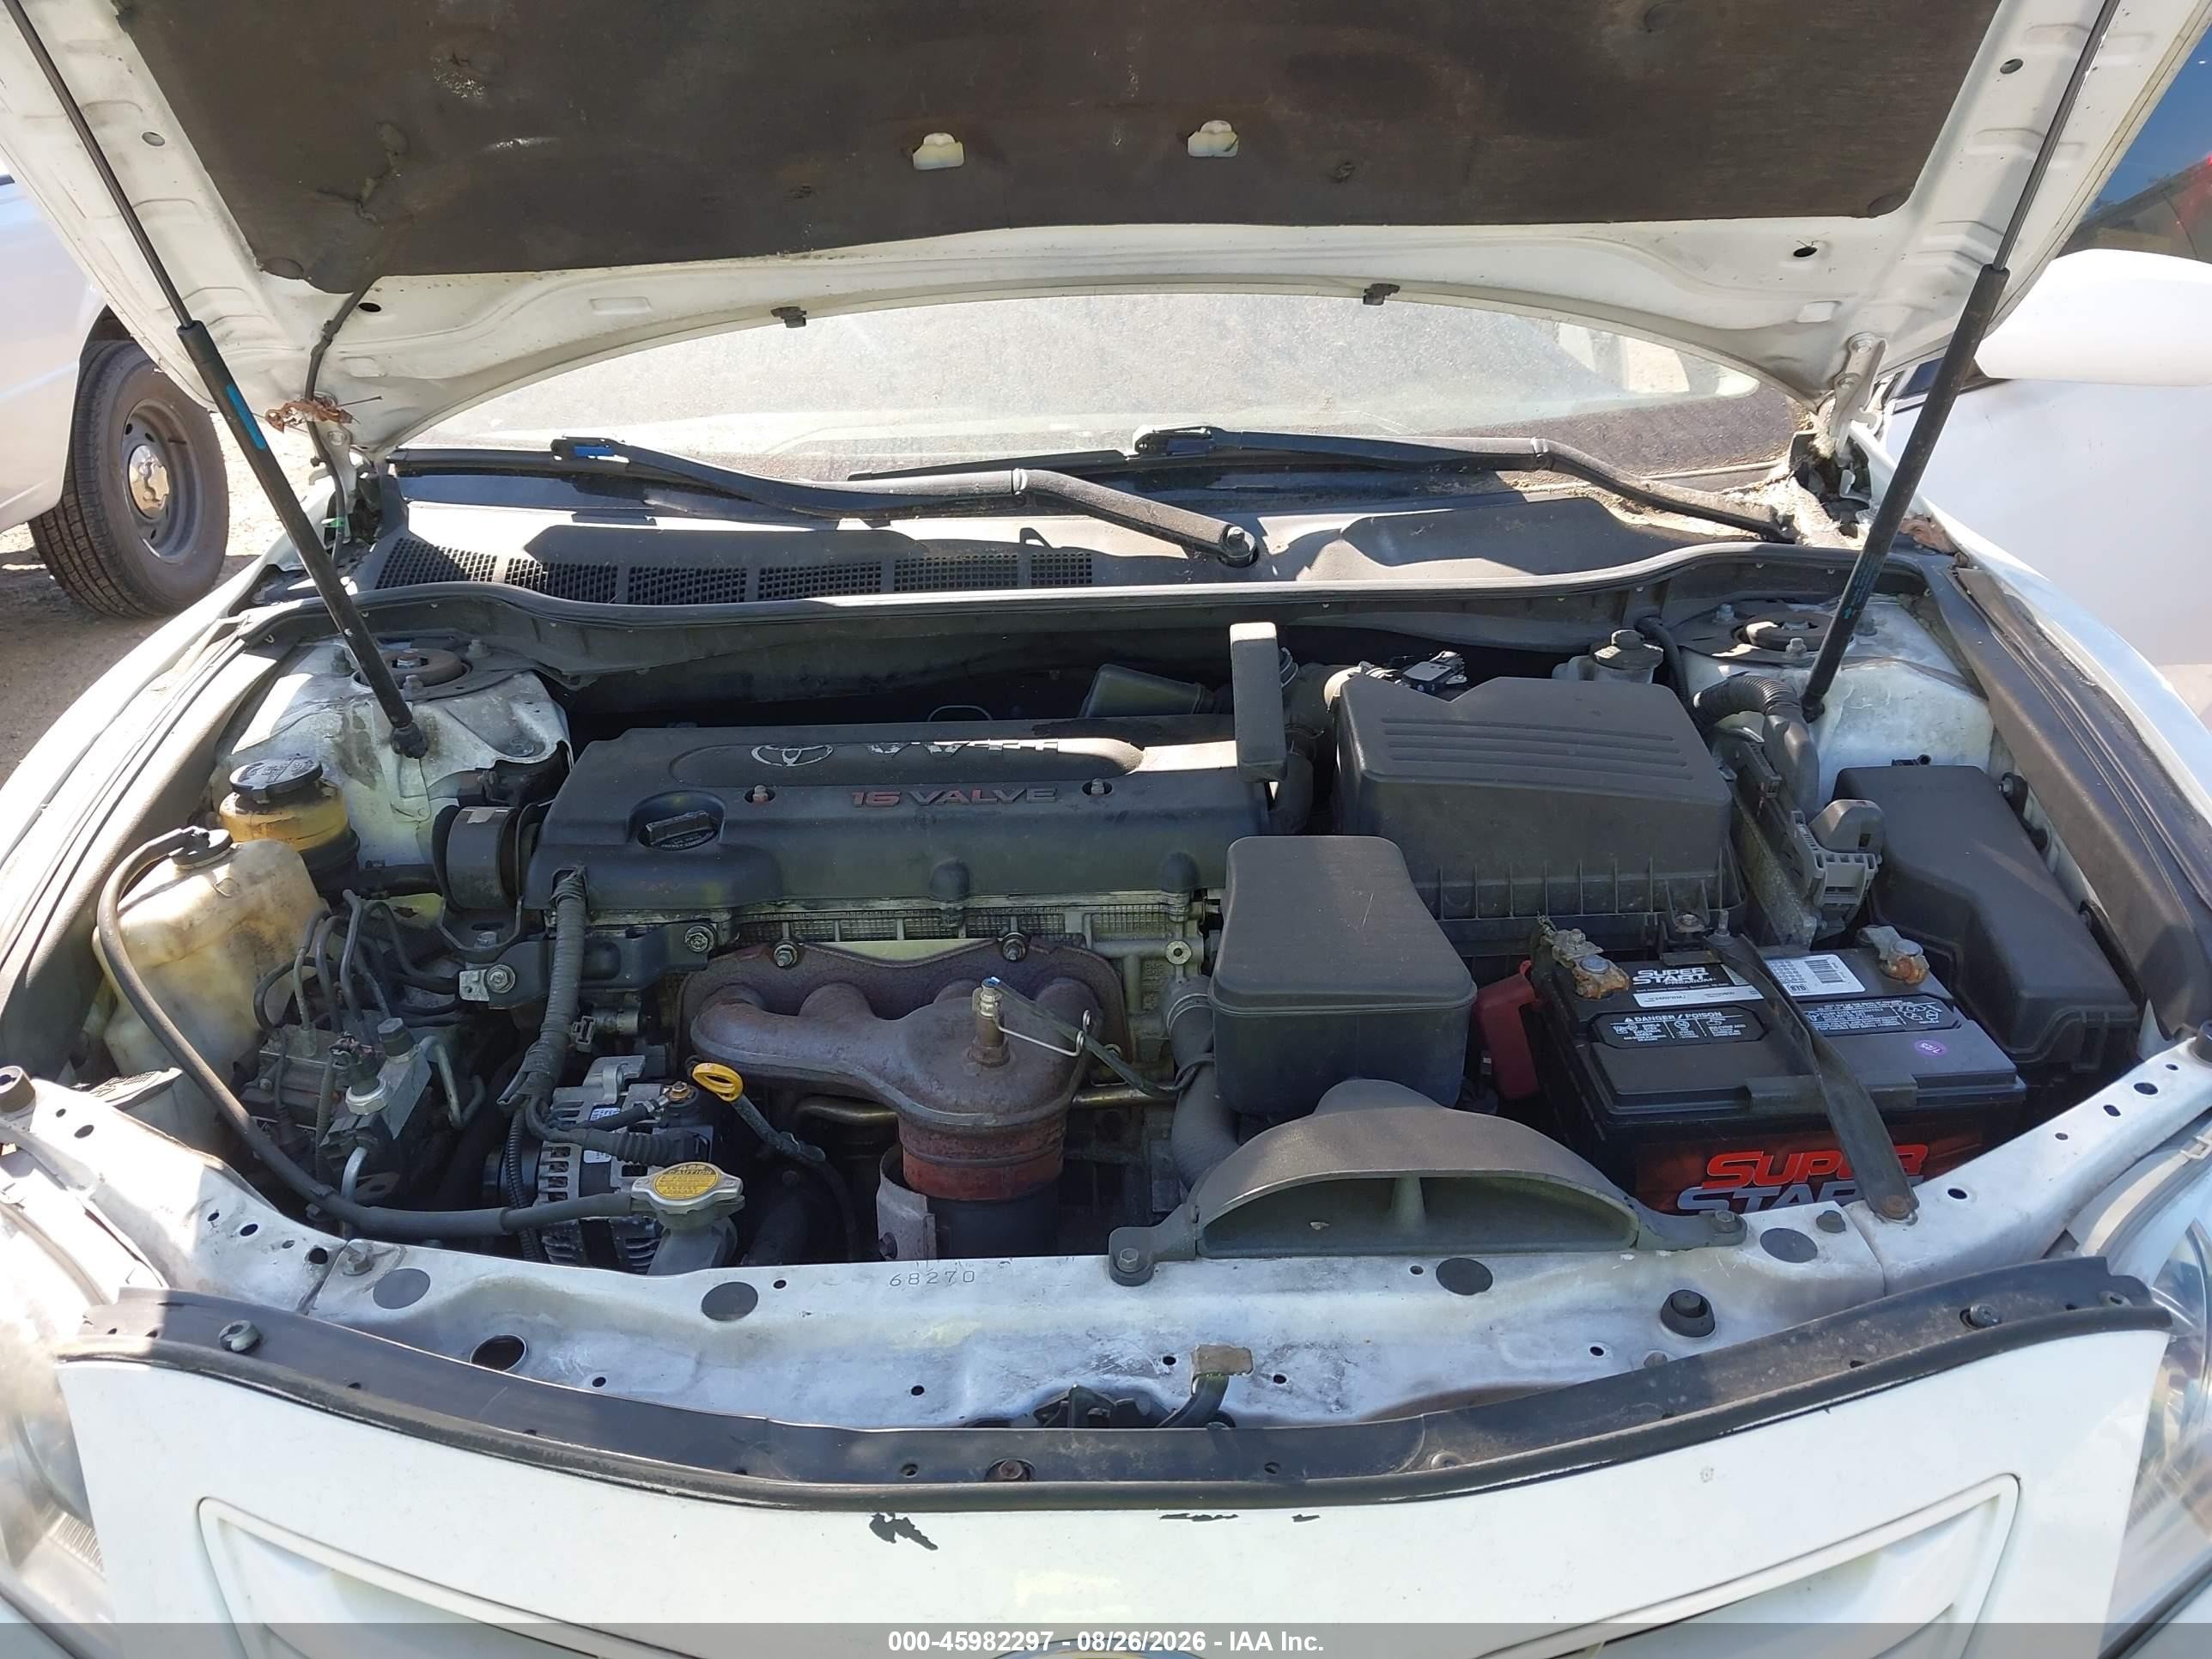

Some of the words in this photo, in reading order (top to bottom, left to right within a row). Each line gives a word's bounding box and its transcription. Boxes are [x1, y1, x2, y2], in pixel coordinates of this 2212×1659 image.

[852, 790, 901, 808] 16
[908, 787, 1059, 806] VALVE
[1632, 974, 1710, 986] START
[1637, 967, 1707, 977] SUPER
[1702, 1144, 1929, 1189] SUPR
[1677, 1175, 1924, 1213] STAR
[889, 1270, 975, 1286] 68270
